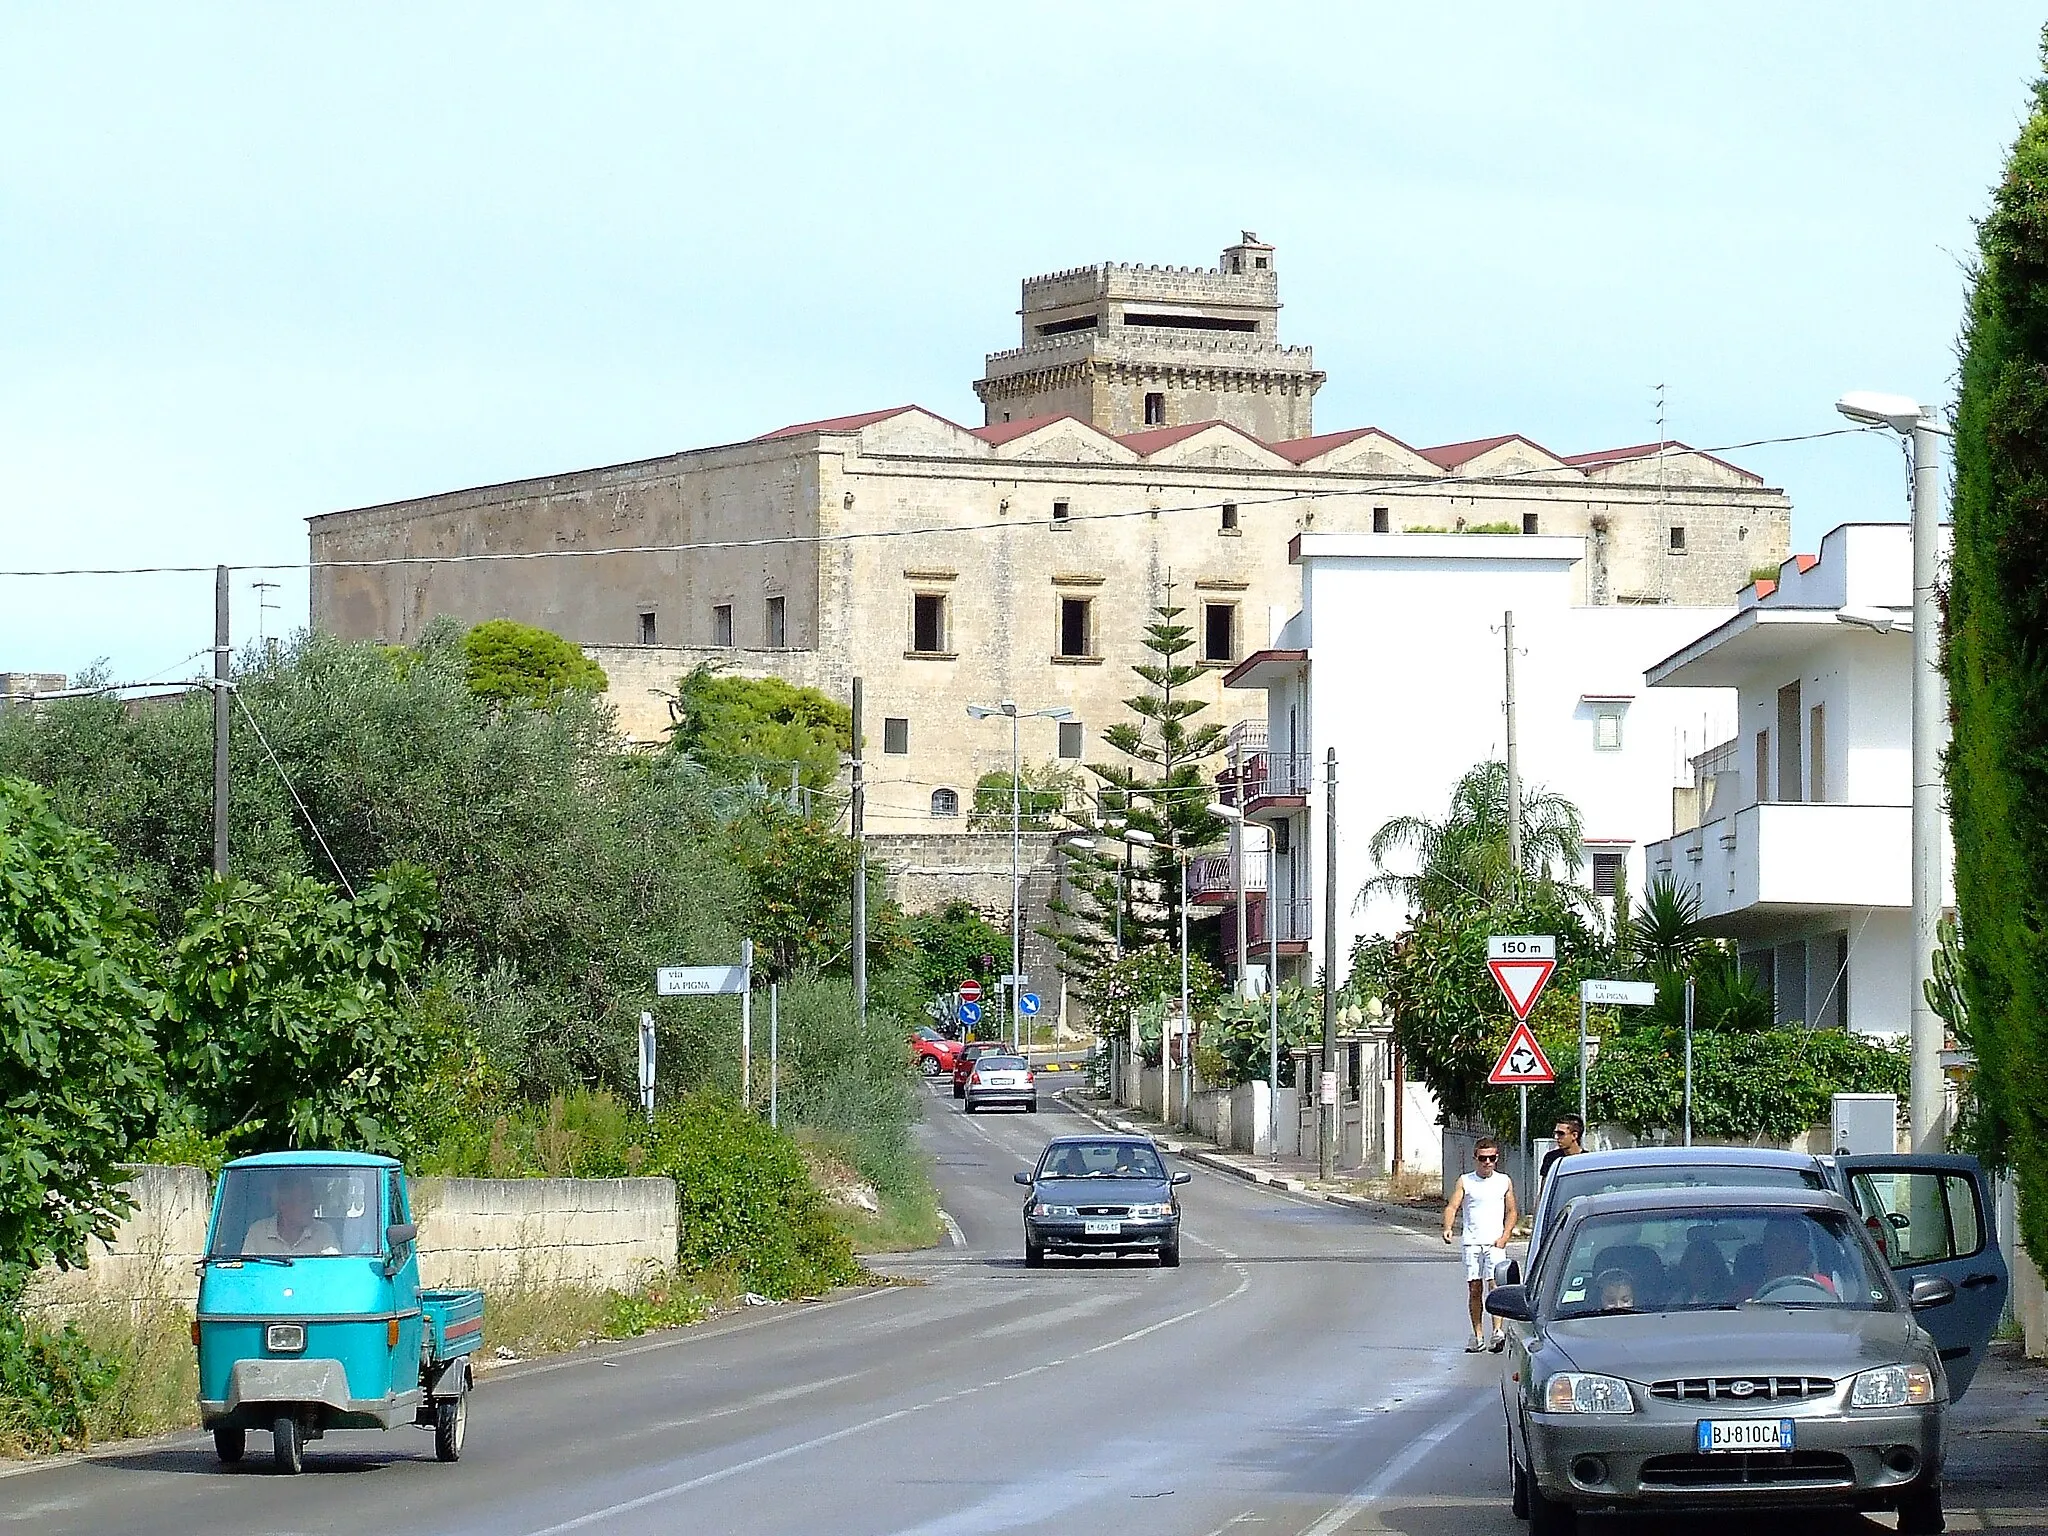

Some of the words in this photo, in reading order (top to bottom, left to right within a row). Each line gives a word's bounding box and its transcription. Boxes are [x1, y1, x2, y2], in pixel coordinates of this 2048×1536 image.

[1502, 942, 1526, 953] 150
[1530, 945, 1541, 953] m
[668, 970, 683, 978] via
[669, 982, 681, 990] LA
[682, 981, 710, 990] PIGNA
